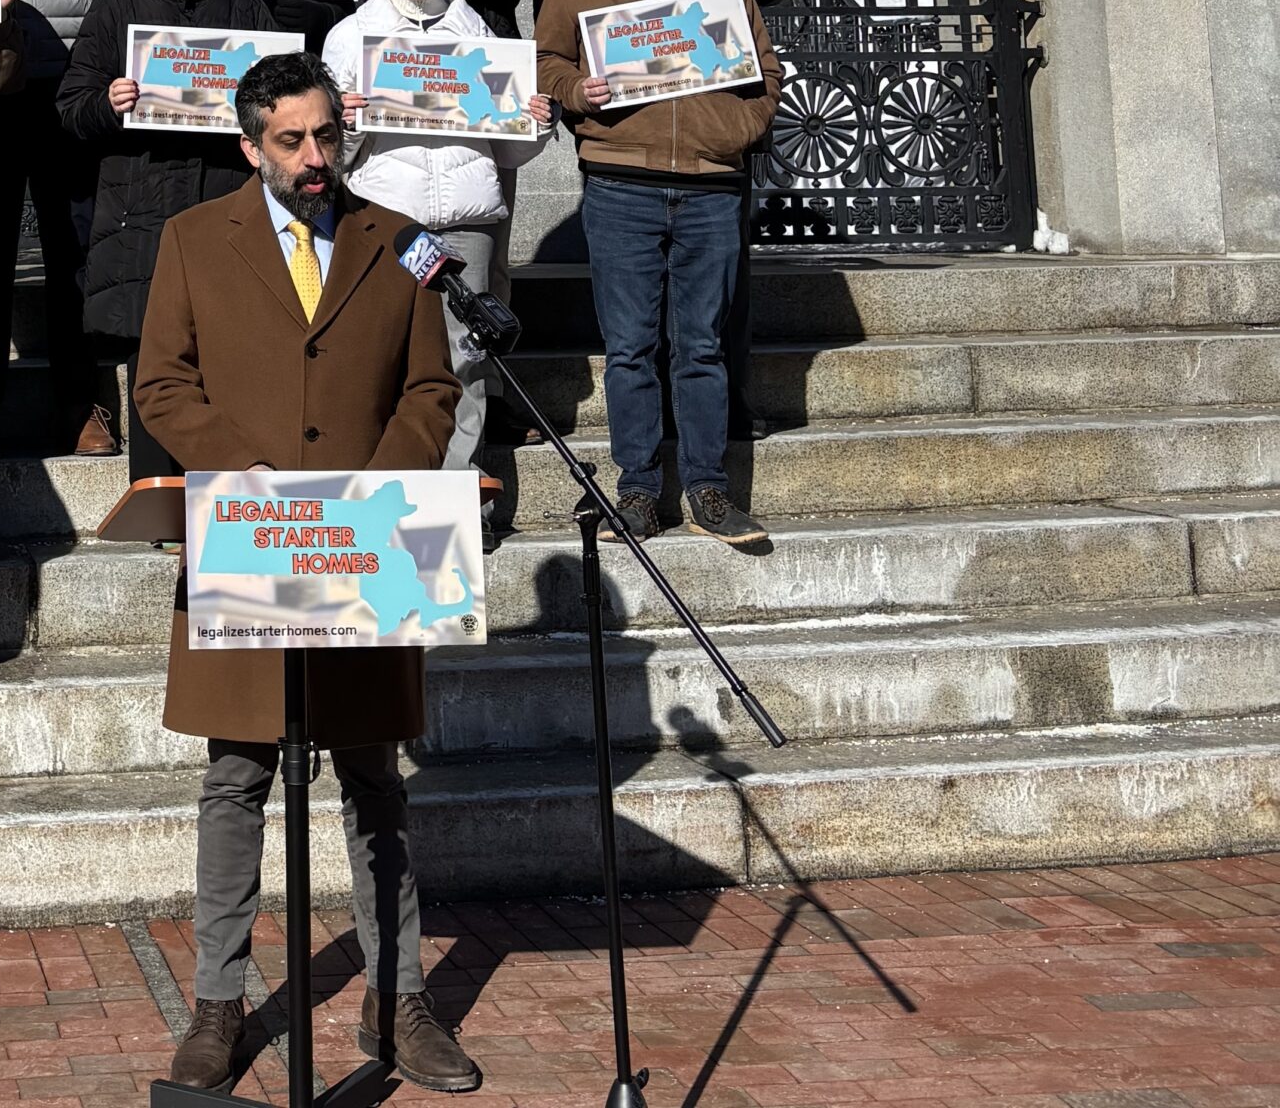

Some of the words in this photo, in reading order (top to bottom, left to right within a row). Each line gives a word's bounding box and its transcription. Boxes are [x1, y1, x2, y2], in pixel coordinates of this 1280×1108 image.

[608, 18, 664, 39] LEGALIZE
[630, 29, 683, 48] STARTER
[152, 47, 210, 60] LEGALIZE
[652, 39, 698, 57] HOMES
[383, 52, 440, 66] LEGALIZE
[172, 62, 226, 75] STARTER
[403, 66, 458, 80] STARTER
[192, 76, 239, 89] HOMES
[423, 80, 470, 94] HOMES
[136, 111, 223, 121] legalizestarterhomes.com
[369, 114, 455, 125] legalizestarterhomes.com
[415, 249, 442, 280] NEWS
[215, 500, 324, 523] LEGALIZE
[253, 526, 357, 549] STARTER
[292, 552, 380, 575] HOMES
[197, 625, 358, 640] legalizestarterhomes.com
